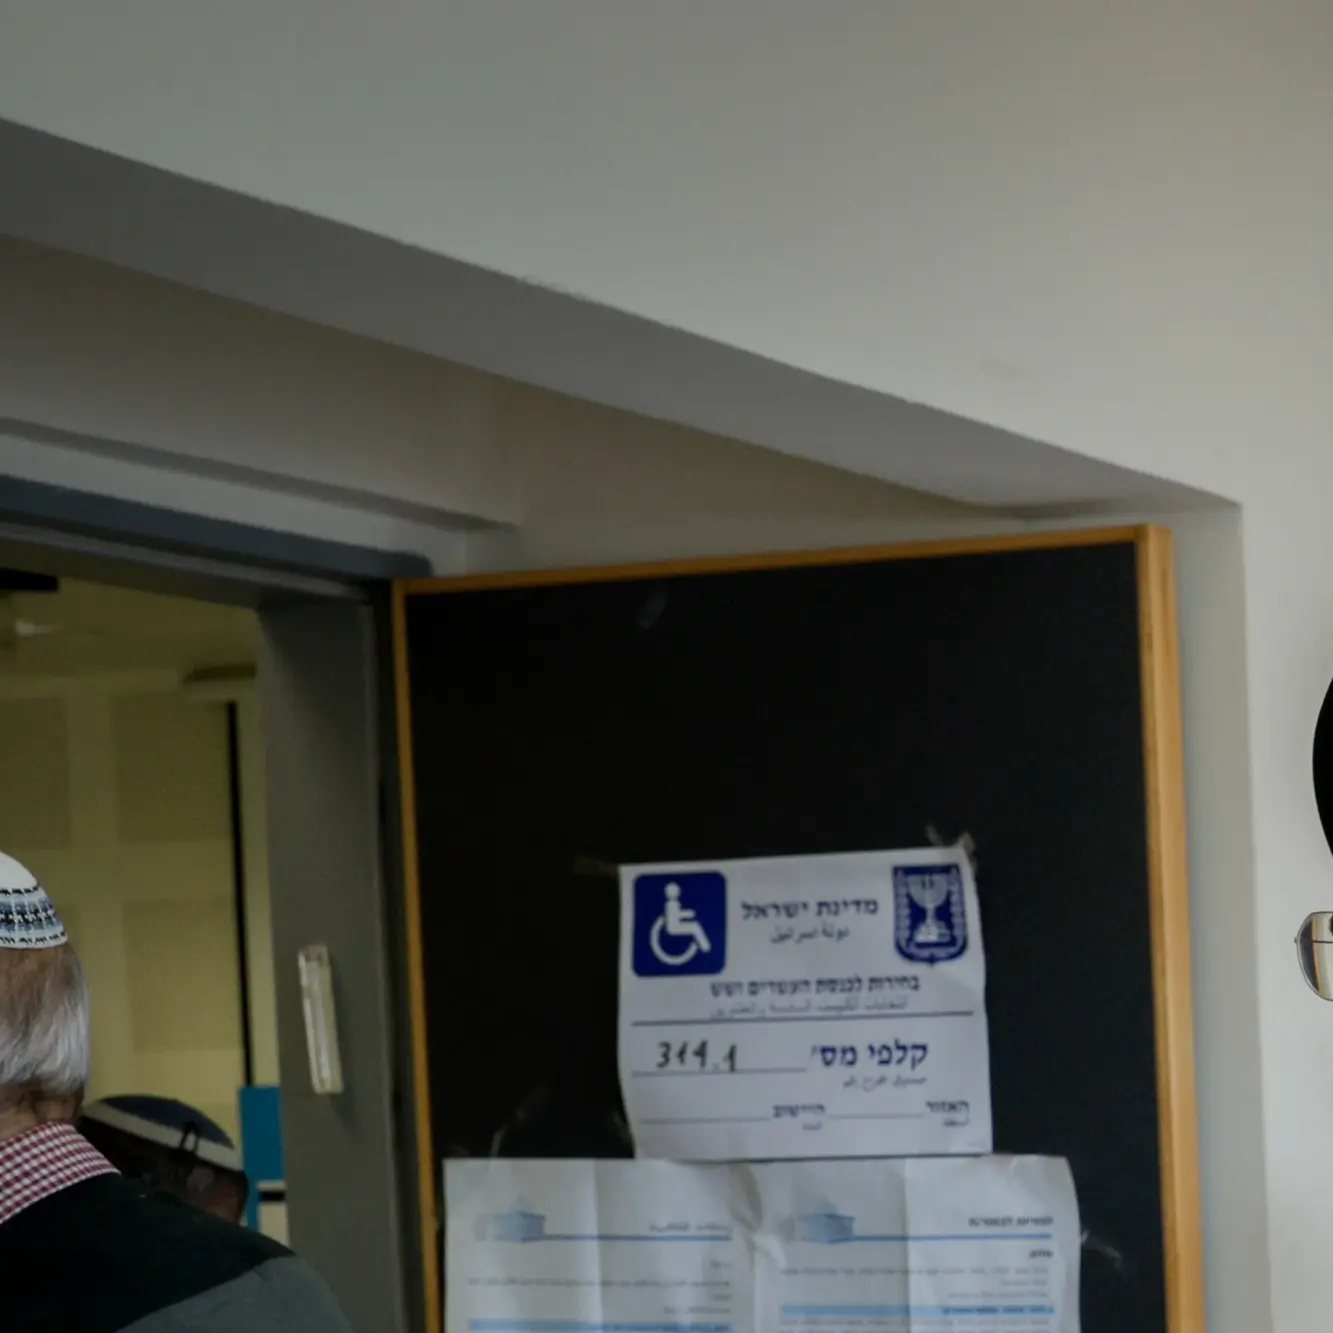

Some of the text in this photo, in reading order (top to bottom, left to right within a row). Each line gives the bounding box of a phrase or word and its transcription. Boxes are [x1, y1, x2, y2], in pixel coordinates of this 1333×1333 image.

[740, 899, 878, 920] מדינת ישראל
[868, 1037, 929, 1071] קלפי
